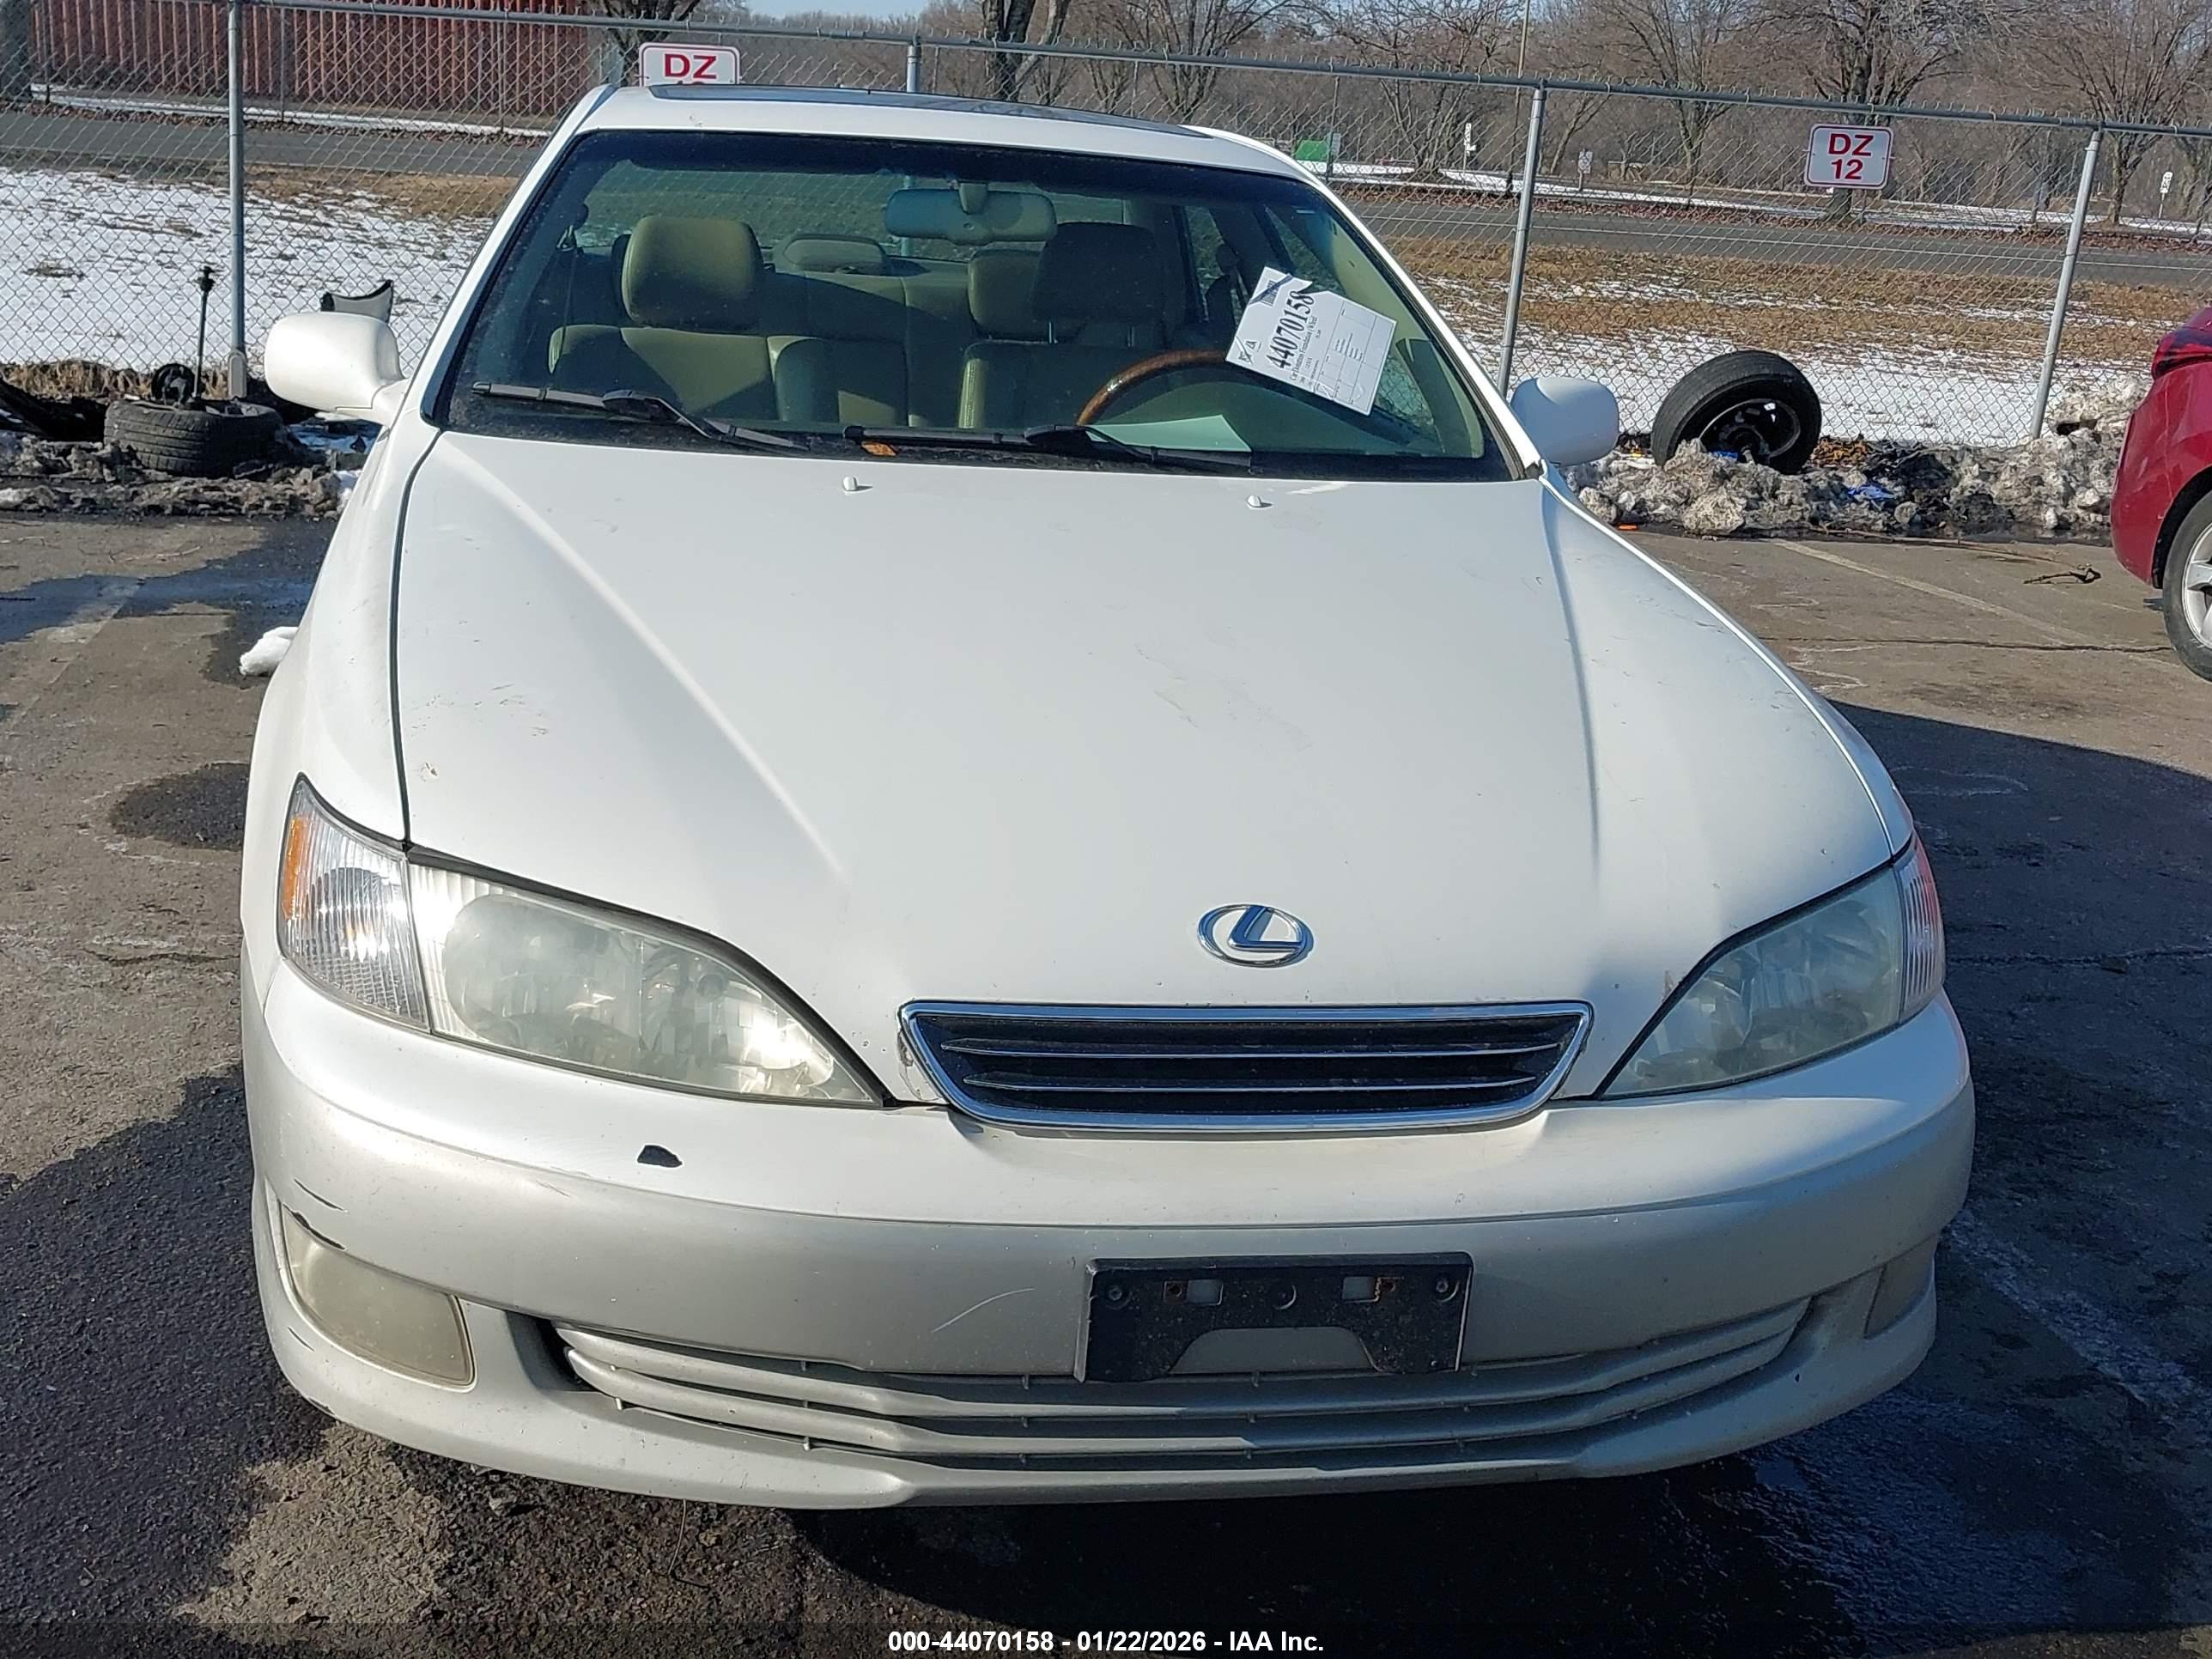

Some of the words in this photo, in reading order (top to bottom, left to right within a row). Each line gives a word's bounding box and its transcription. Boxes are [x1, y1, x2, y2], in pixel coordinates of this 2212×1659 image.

[665, 53, 717, 79] DZ
[1828, 133, 1874, 156] DZ
[1832, 159, 1863, 179] 12
[1265, 290, 1314, 368] 44070158
